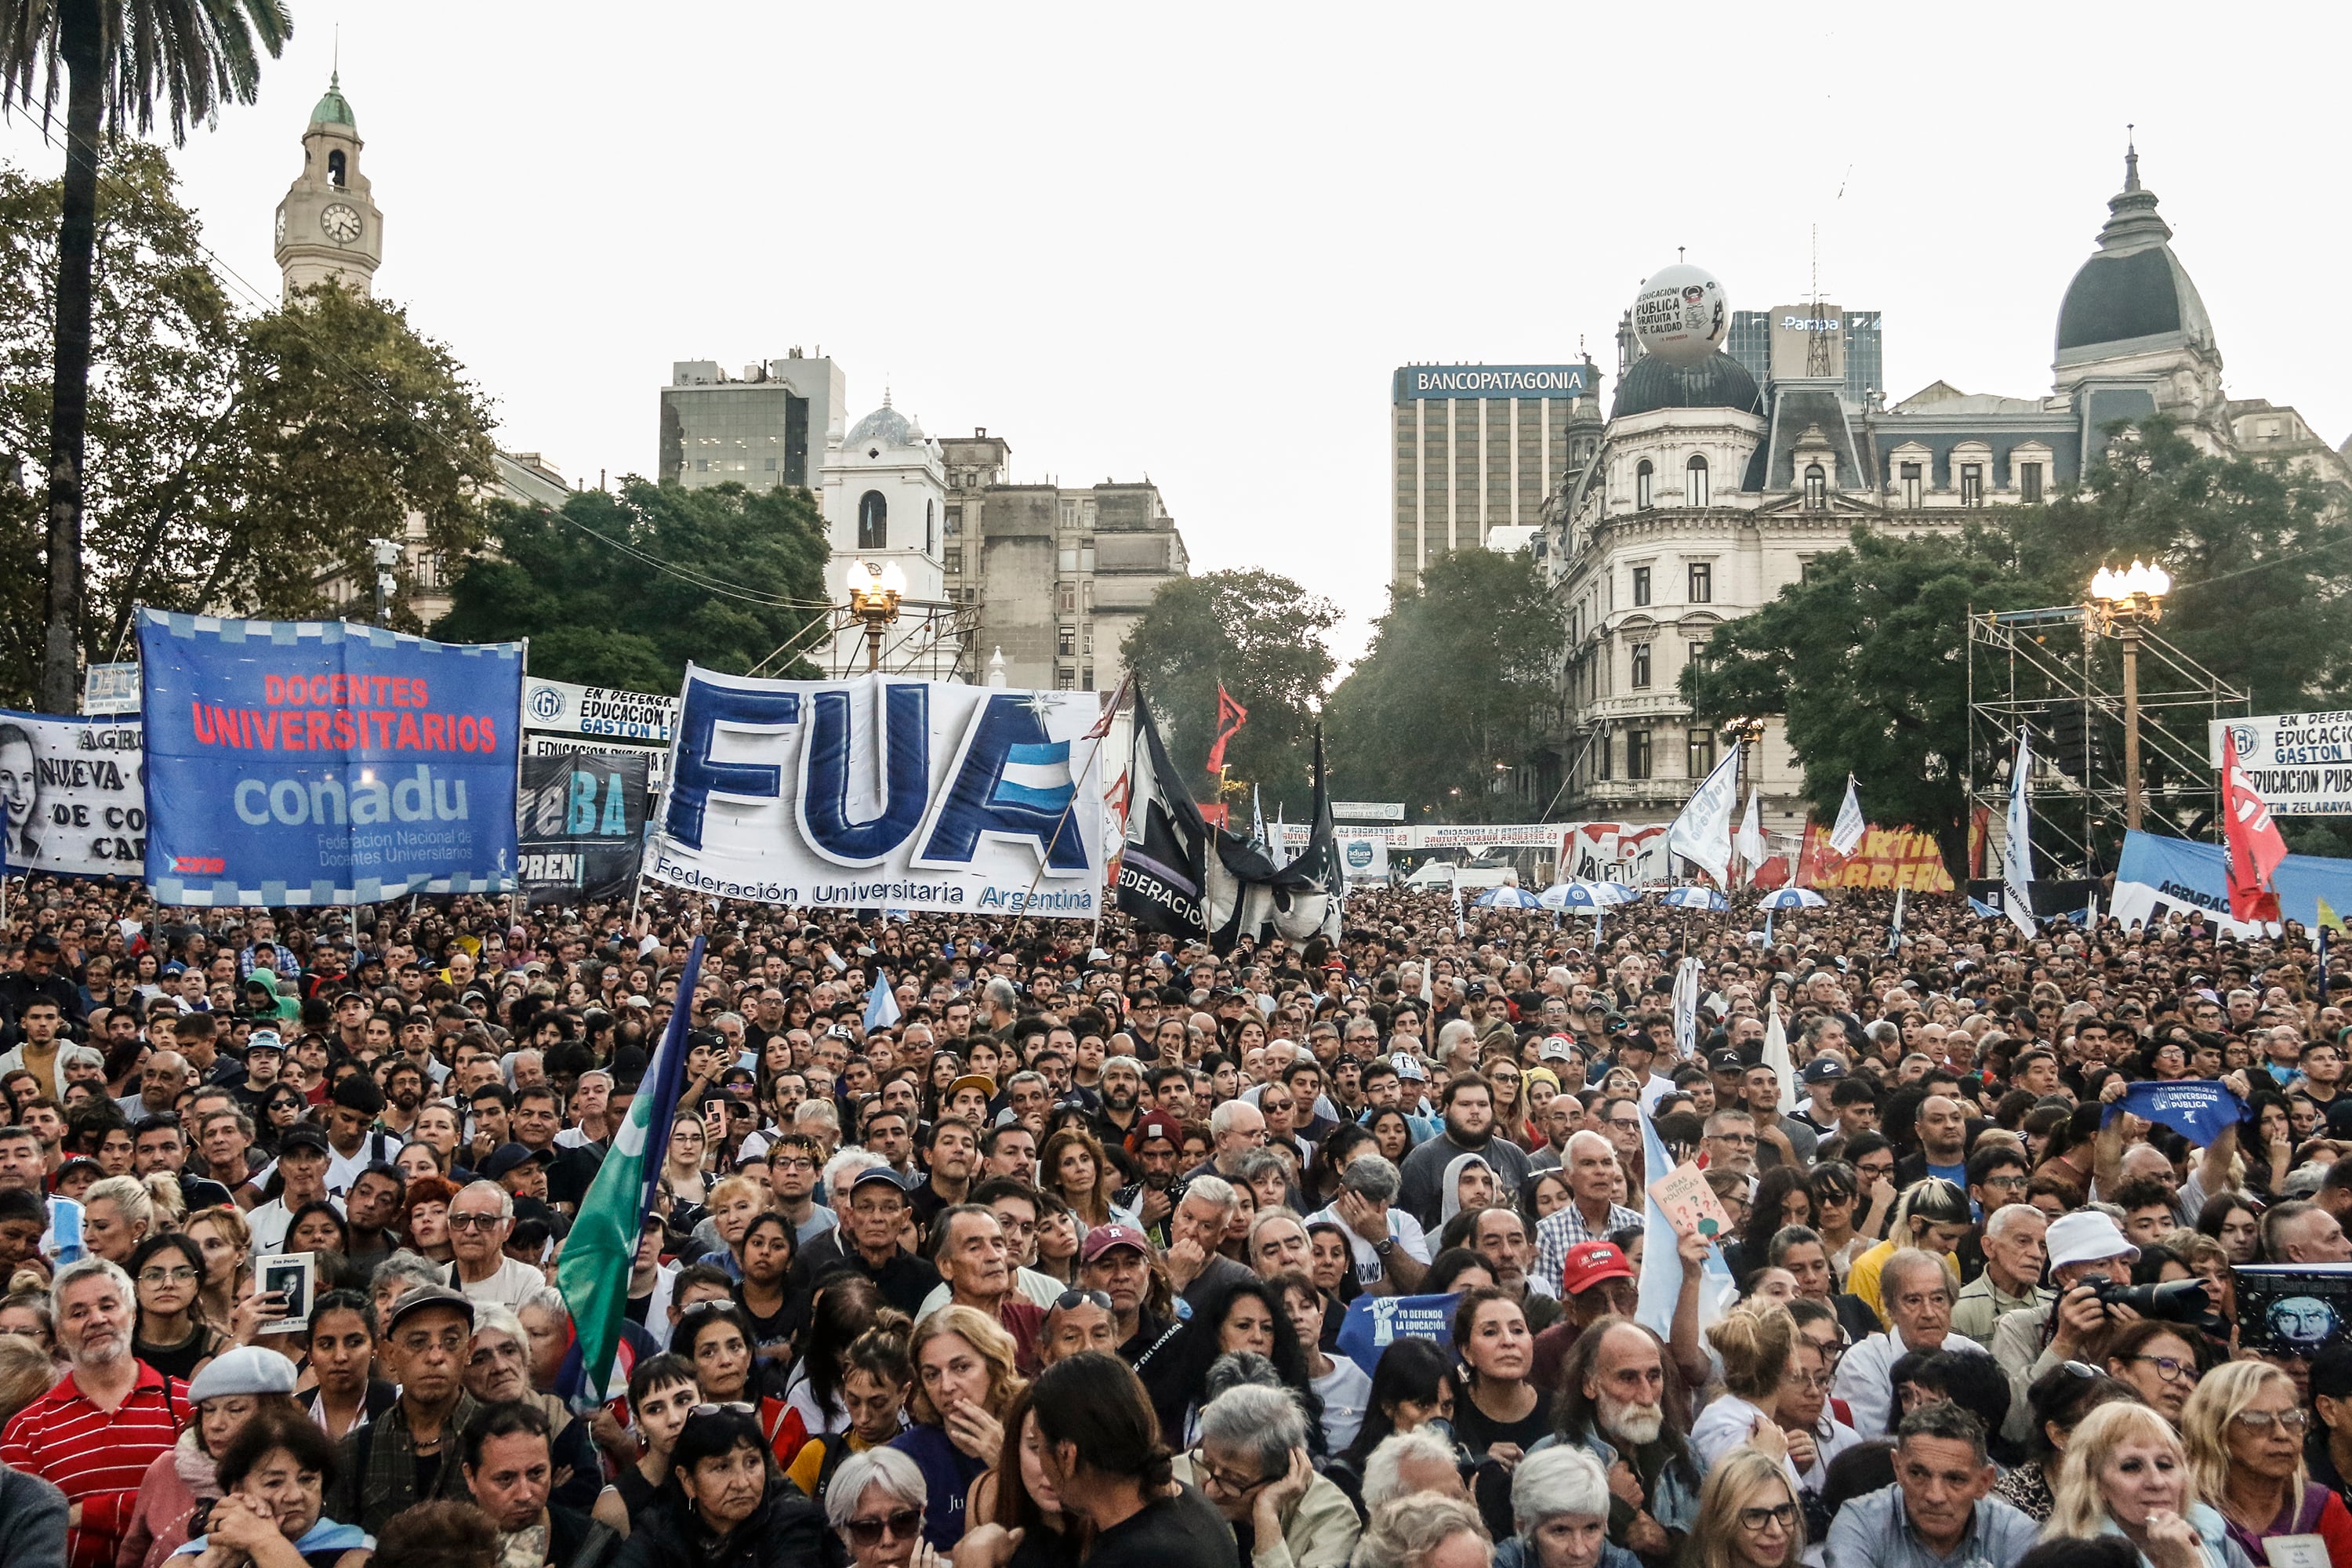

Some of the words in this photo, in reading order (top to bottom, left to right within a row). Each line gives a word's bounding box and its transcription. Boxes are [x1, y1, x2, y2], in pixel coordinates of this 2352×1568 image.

[1636, 297, 1680, 315] PÚBLICA
[1637, 312, 1671, 325] GRATUITA
[1675, 310, 1680, 320] Y
[1639, 325, 1648, 334] DE
[1650, 321, 1682, 333] CALIDAD
[1417, 372, 1582, 390] BANCOPATAGONIA
[264, 673, 429, 708] DOCENTES
[584, 688, 604, 699] EN
[192, 702, 496, 753] UNIVERSITARIOS
[580, 718, 650, 738] GASTON
[2279, 715, 2298, 727] EN
[2275, 744, 2342, 764] GASTON
[38, 757, 125, 791] NUEVA
[666, 677, 1090, 869] FUA
[234, 764, 469, 826] conadu
[53, 804, 91, 828] DE
[397, 828, 455, 845] Nacional
[458, 829, 471, 844] de
[320, 850, 381, 867] Docentes
[386, 846, 473, 863] Universitarios
[655, 856, 799, 903] Federación
[813, 878, 965, 904] Universitaria
[979, 885, 1092, 910] Argentina
[2168, 1092, 2218, 1102] UNIVERSIDAD
[1664, 1176, 1687, 1192] IDEAS
[1109, 1228, 1122, 1238] R
[1592, 1250, 1612, 1259] GINZA
[1398, 1309, 1408, 1319] YO
[1409, 1309, 1443, 1319] DEFIENDO
[1396, 1320, 1404, 1330] LA
[1406, 1319, 1446, 1330] EDUCACIÓN
